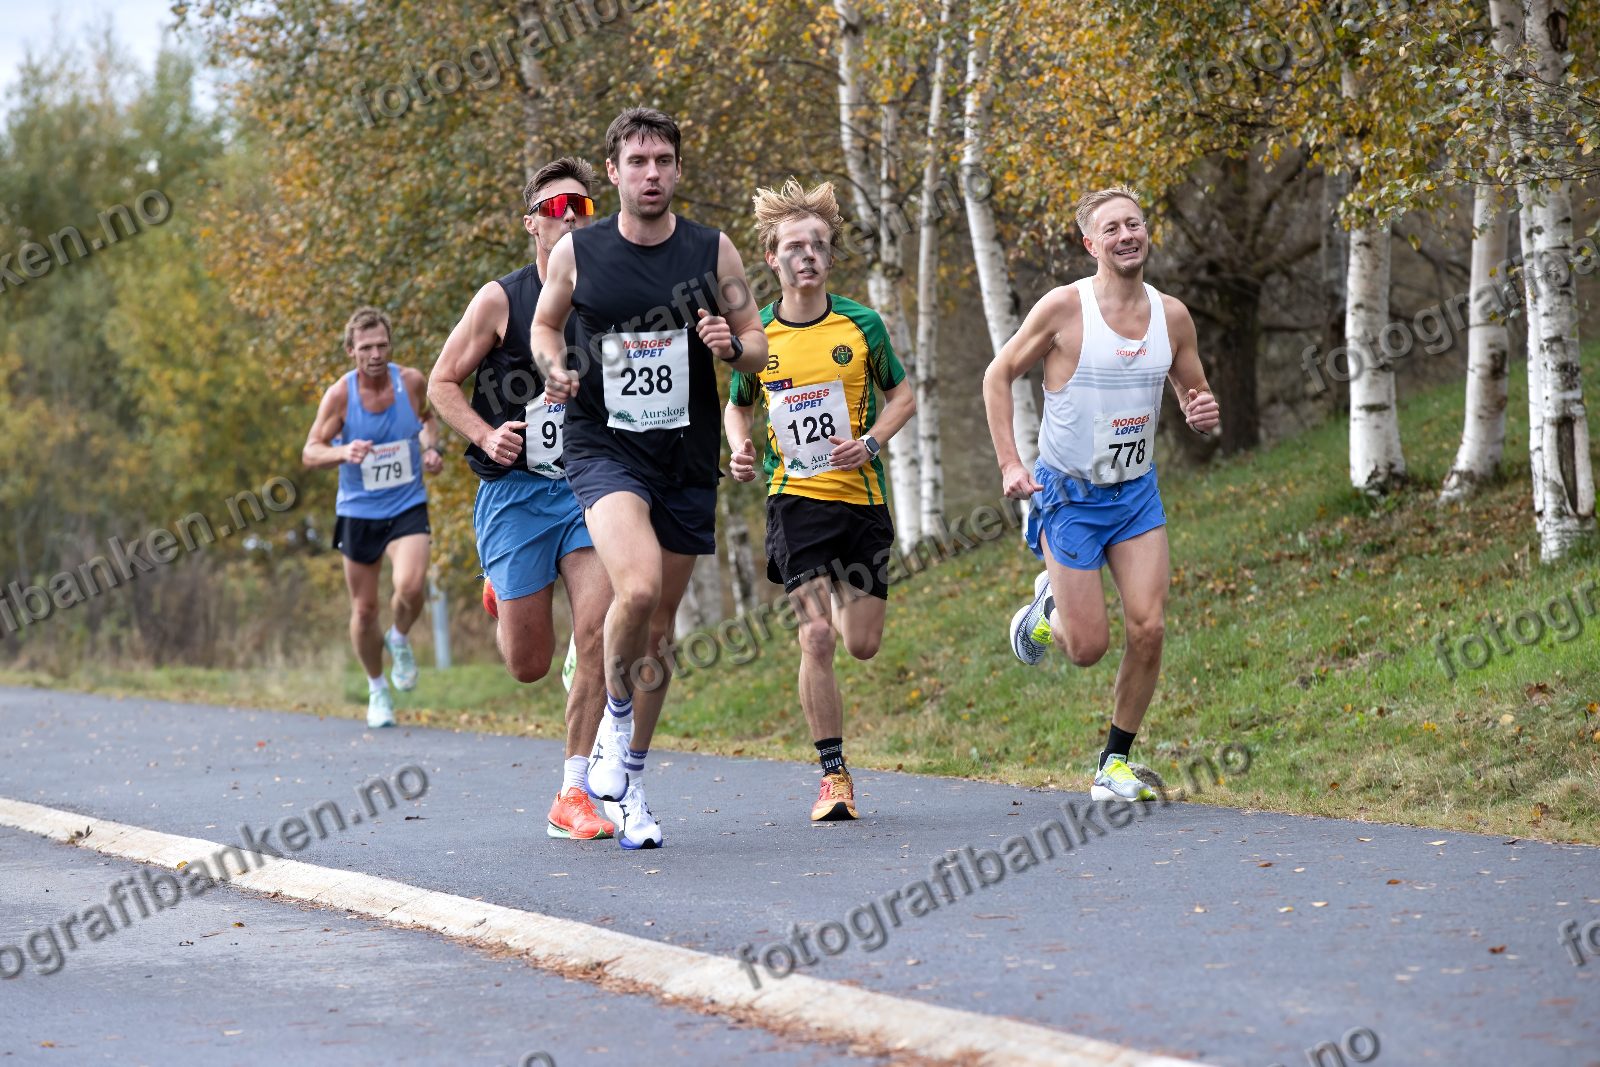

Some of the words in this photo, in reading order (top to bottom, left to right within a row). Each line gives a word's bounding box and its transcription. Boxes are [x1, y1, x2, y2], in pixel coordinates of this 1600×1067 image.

[623, 338, 673, 349] NORGES
[626, 348, 665, 359] LØPET
[620, 364, 673, 396] 238
[783, 388, 830, 404] NORGES
[640, 406, 686, 419] Aurskog
[789, 398, 824, 413] LØPET
[1112, 413, 1150, 428] NORGES
[787, 412, 836, 446] 128
[1115, 424, 1145, 436] LØPET
[1108, 438, 1146, 470] 778
[371, 460, 403, 482] 779
